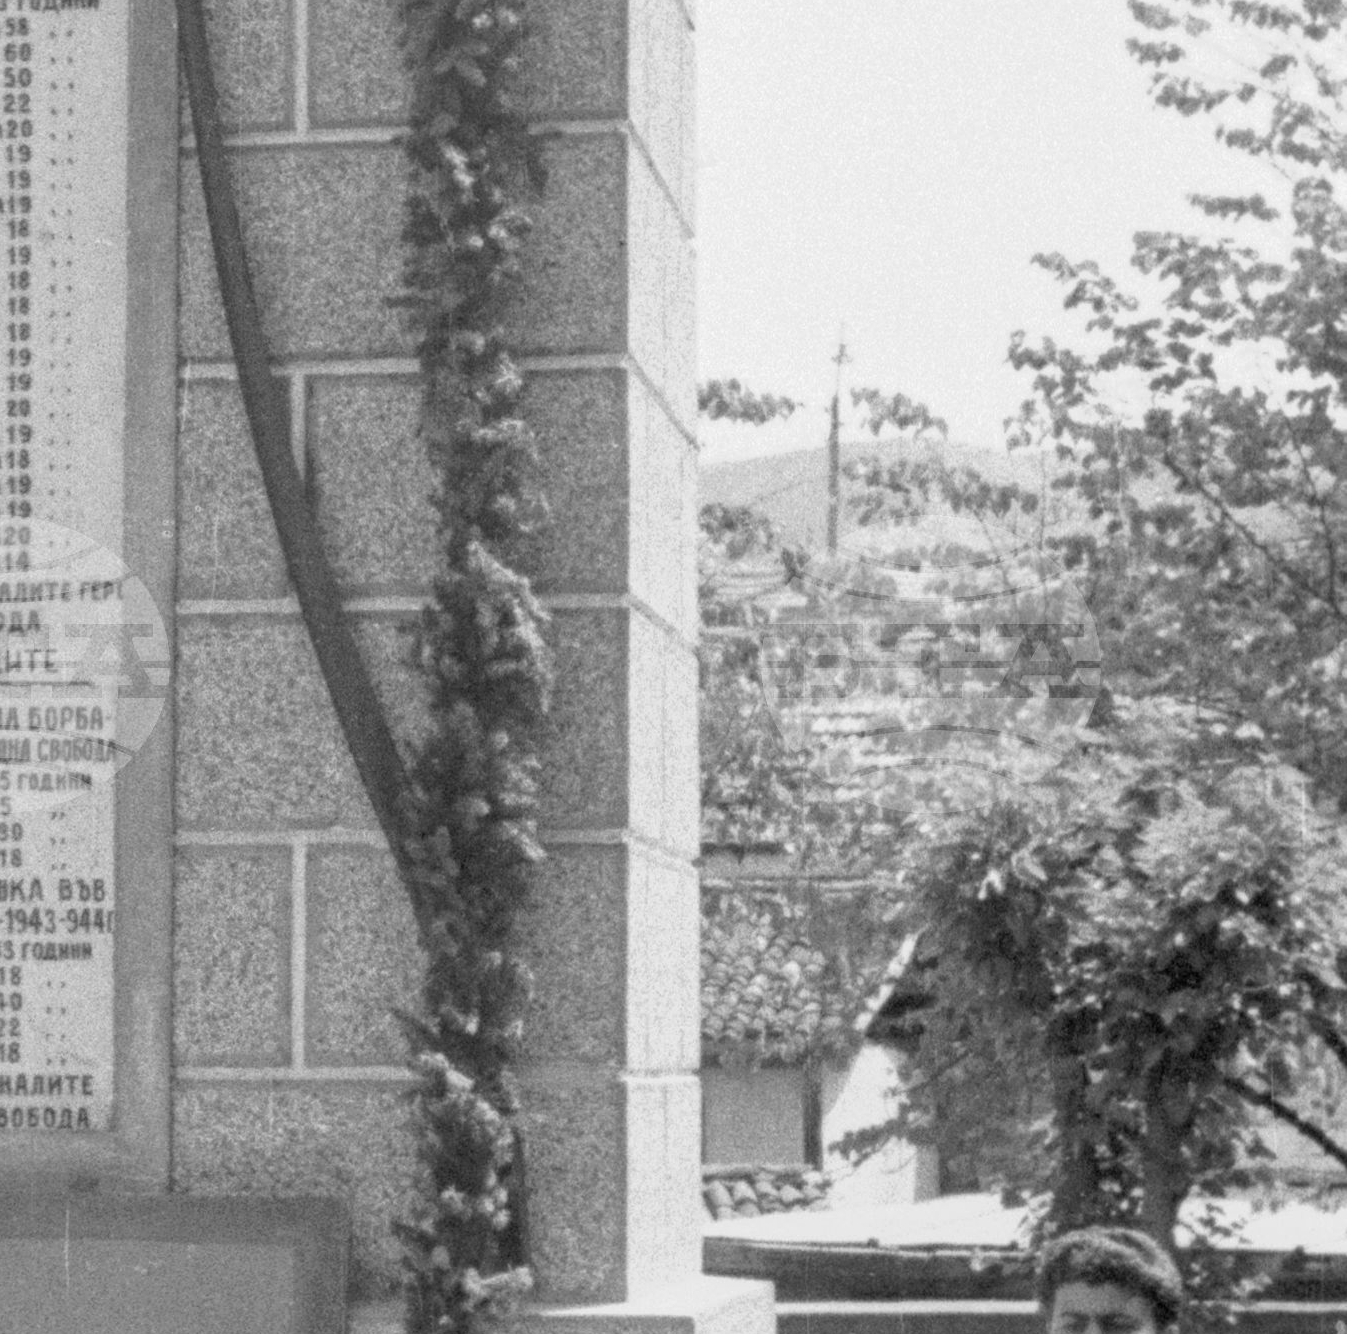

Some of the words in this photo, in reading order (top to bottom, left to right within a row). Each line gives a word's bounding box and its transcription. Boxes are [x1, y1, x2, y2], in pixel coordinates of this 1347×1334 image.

[4, 42, 31, 63] 60
[4, 68, 31, 88] 50
[4, 93, 31, 113] 22
[6, 119, 32, 139] 20
[6, 144, 31, 163] 19
[8, 170, 31, 189] 19
[8, 196, 31, 214] 19
[8, 246, 31, 265] 19
[8, 348, 31, 367] 19
[8, 373, 31, 392] 19
[7, 399, 30, 417] 20
[7, 424, 32, 444] 19
[8, 474, 31, 495] 19
[8, 501, 31, 518] 19
[4, 526, 30, 546] 20
[0, 849, 22, 867] 18
[59, 878, 105, 902] ВЪВ
[21, 942, 92, 960] ГОДИНИ
